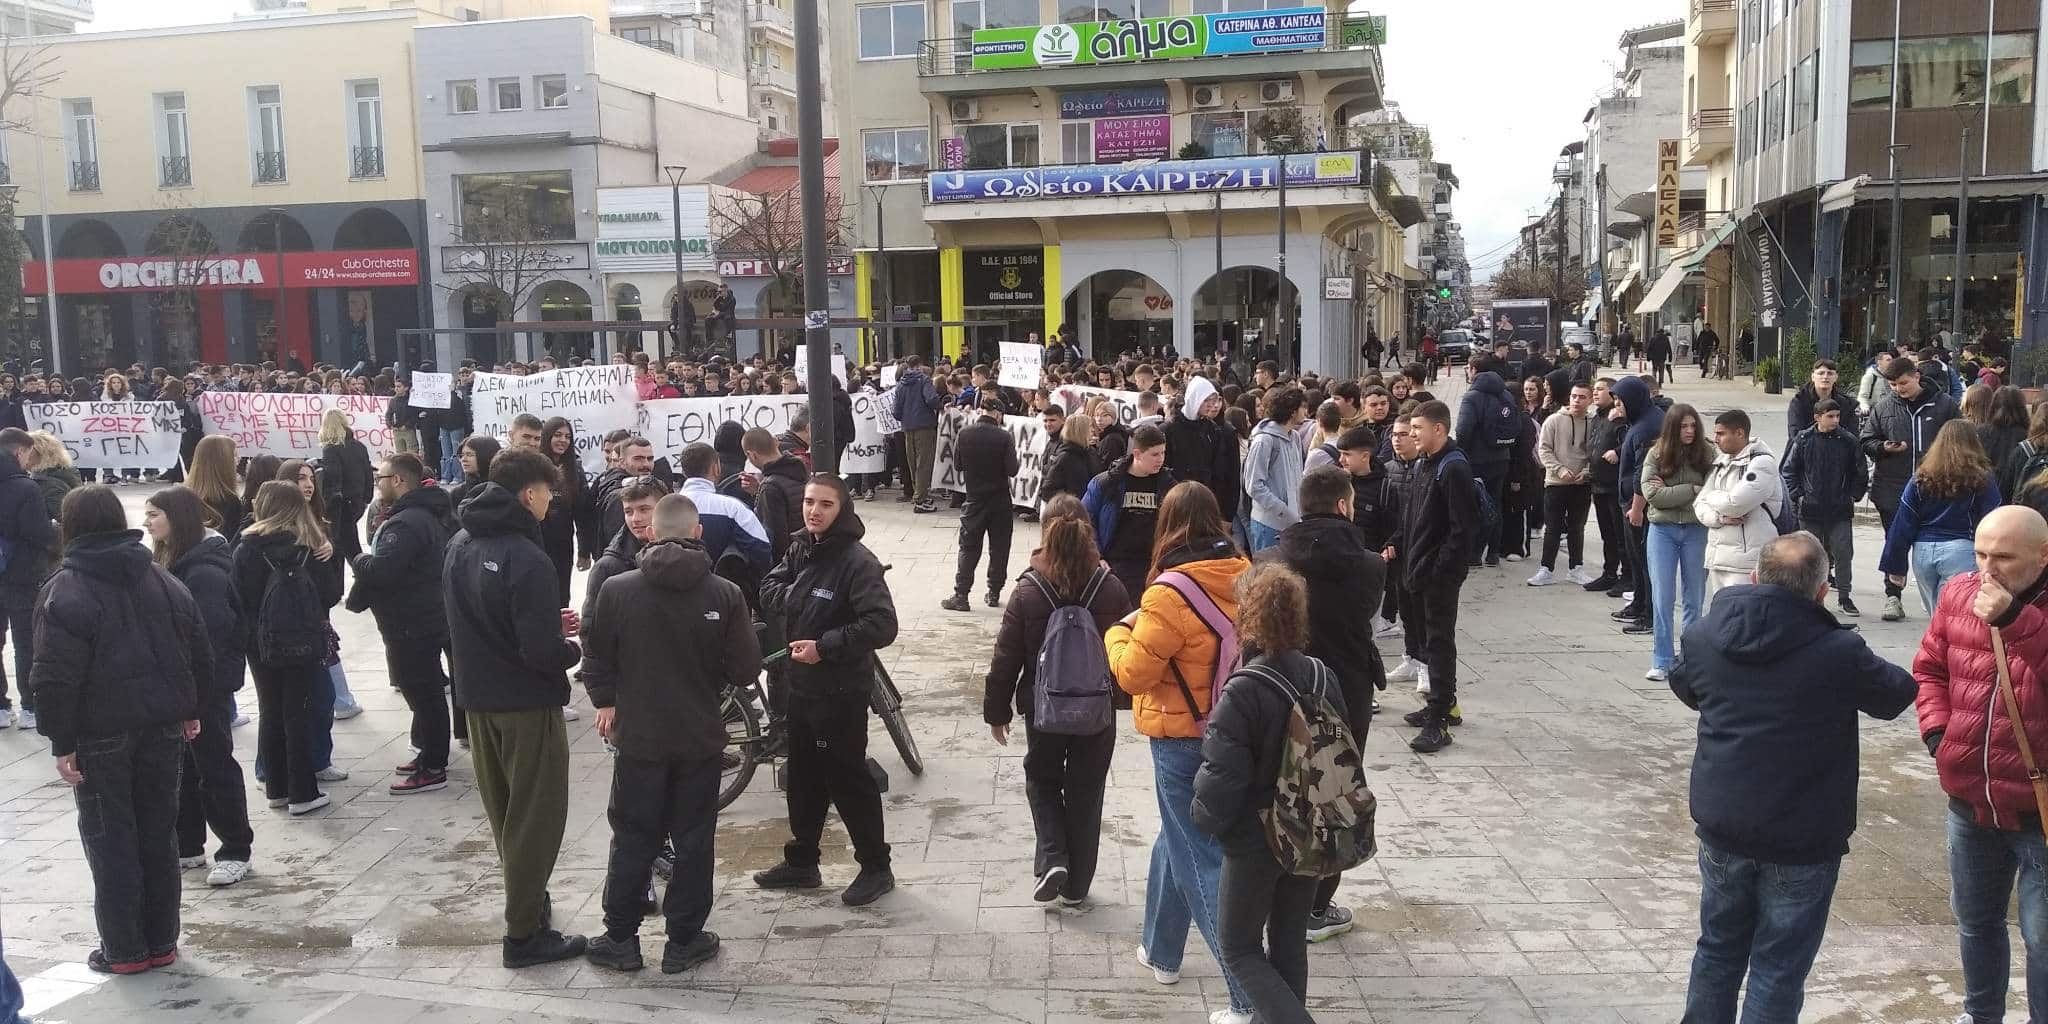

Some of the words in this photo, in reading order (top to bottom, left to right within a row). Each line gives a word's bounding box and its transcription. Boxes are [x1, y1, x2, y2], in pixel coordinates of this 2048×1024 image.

[1218, 18, 1261, 33] ΚΑΤΕΡΙΝΑ
[1262, 17, 1278, 29] ΑΘ.
[1280, 15, 1322, 28] ΚΑΝΤΕΛΑ
[975, 43, 1025, 52] ΦΡΟΝΤΙΣΤΗΡΙΟ
[1091, 19, 1196, 59] άλμα
[1256, 33, 1320, 45] ΜΑΘΗΜΑΤΙΚΟΣ
[1117, 97, 1166, 109] ΚΑΡΕΖΗ
[1109, 140, 1156, 148] ΚΑΡΕΖΗ
[984, 170, 1092, 198] Ωδείο
[1102, 167, 1272, 193] ΚΑΡΕΖΗ
[1659, 141, 1678, 246] ΜΠΛΕΚΑΣ
[342, 258, 360, 269] Club
[362, 257, 410, 269] Orchestra
[99, 259, 264, 288] ORCHESTRA
[304, 268, 334, 279] 24/24
[336, 271, 411, 279] www.shop-orchestra.com
[989, 291, 1014, 300] Official
[1014, 291, 1033, 299] Store
[477, 376, 506, 393] ΔΕΝ
[556, 365, 633, 388] ΑΤΥΧΗΜΑ
[30, 402, 81, 420] ΠΟΣΟ
[90, 402, 175, 418] ΚΟΣΤΙΖΟΥΝ
[201, 393, 323, 416] ΔΡΟΜΟΛΟΓΙΟ
[336, 394, 389, 413] ΘΑΝΑΤ
[495, 392, 528, 415] ΗΤΑΝ
[541, 390, 615, 411] ΕΓΚΛΗΜΑ
[42, 420, 64, 435] ΟΙ
[240, 413, 270, 429] ΜΕ
[101, 434, 150, 456] ΓΕΛ
